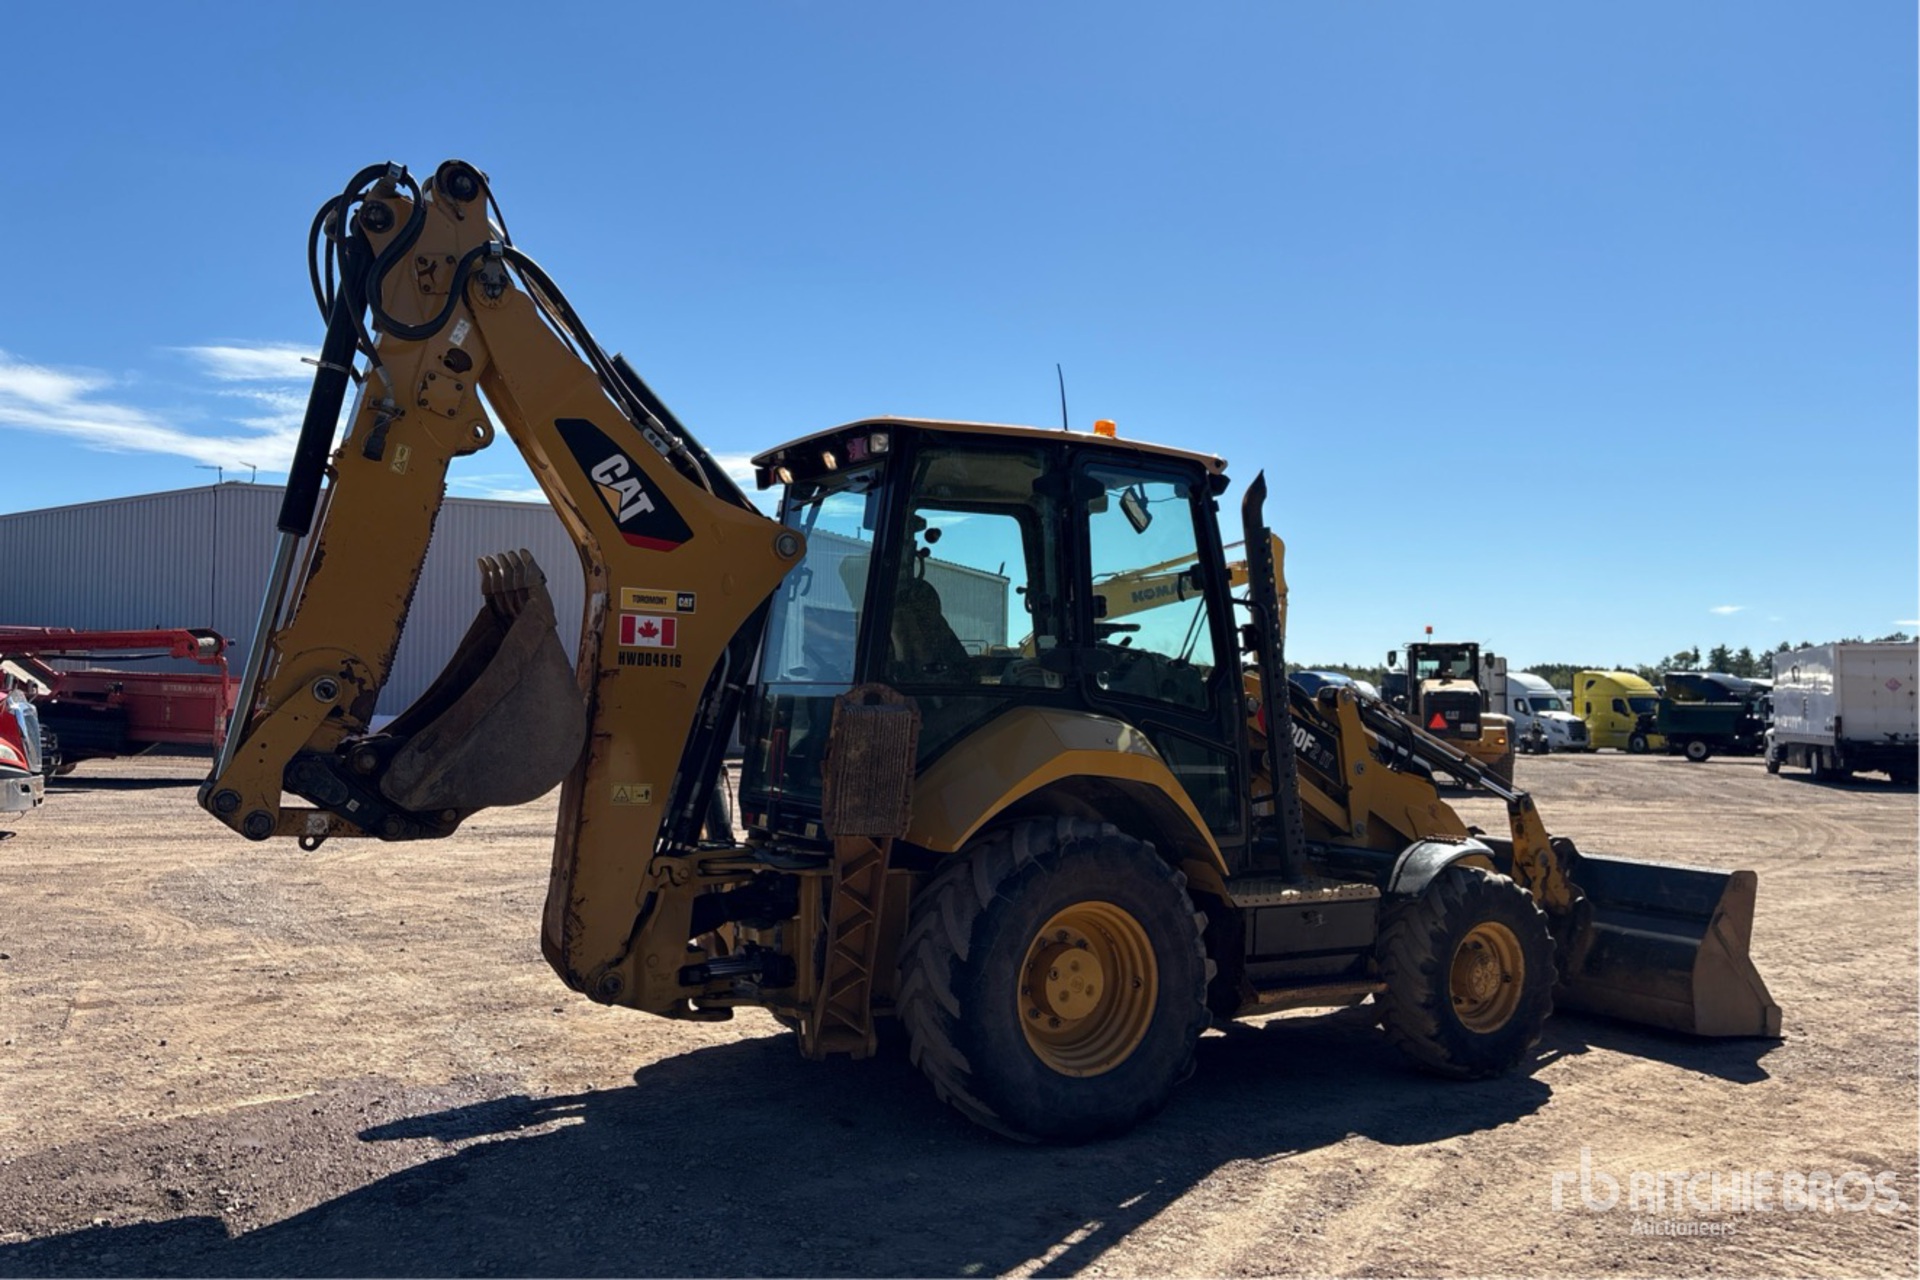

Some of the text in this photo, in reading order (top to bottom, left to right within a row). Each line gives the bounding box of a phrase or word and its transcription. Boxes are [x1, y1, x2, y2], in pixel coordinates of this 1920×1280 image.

[591, 454, 655, 524] CAT
[678, 597, 694, 608] CAT
[1131, 576, 1193, 603] KOMA
